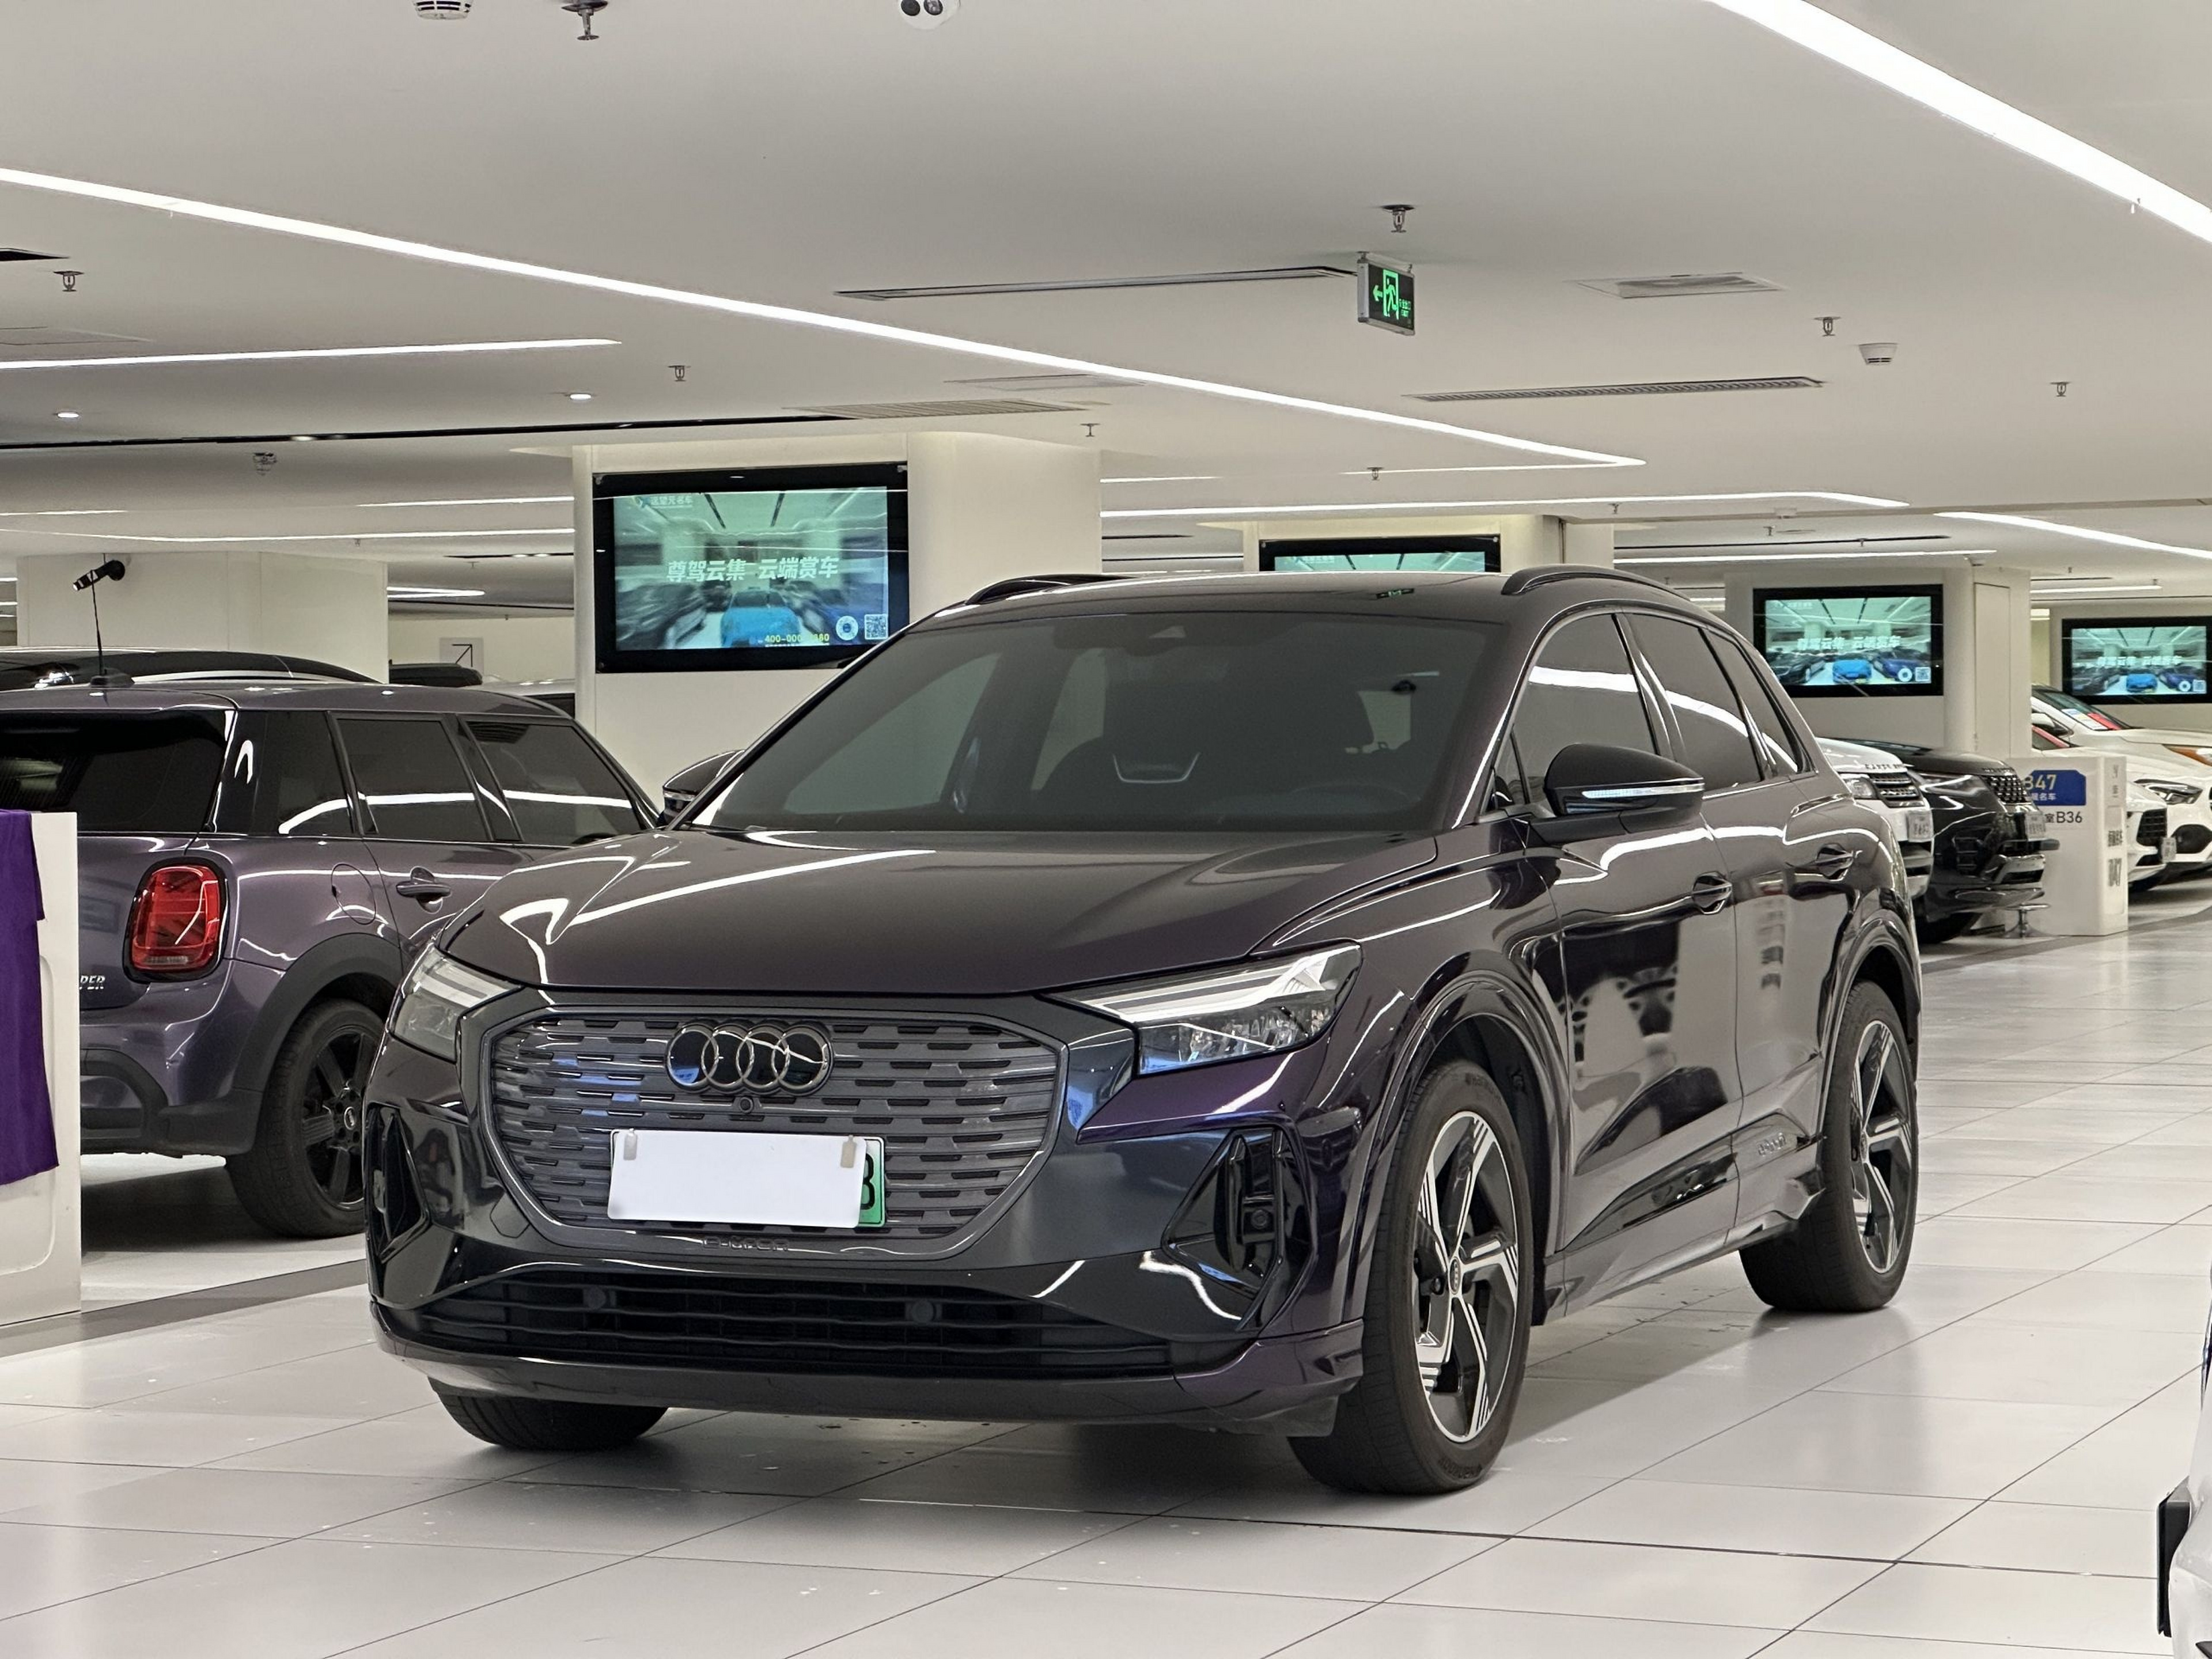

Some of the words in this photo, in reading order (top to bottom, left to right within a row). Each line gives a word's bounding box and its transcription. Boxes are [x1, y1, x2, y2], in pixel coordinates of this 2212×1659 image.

[666, 559, 746, 582] 尊驾云集
[758, 556, 839, 579] 云端赏车
